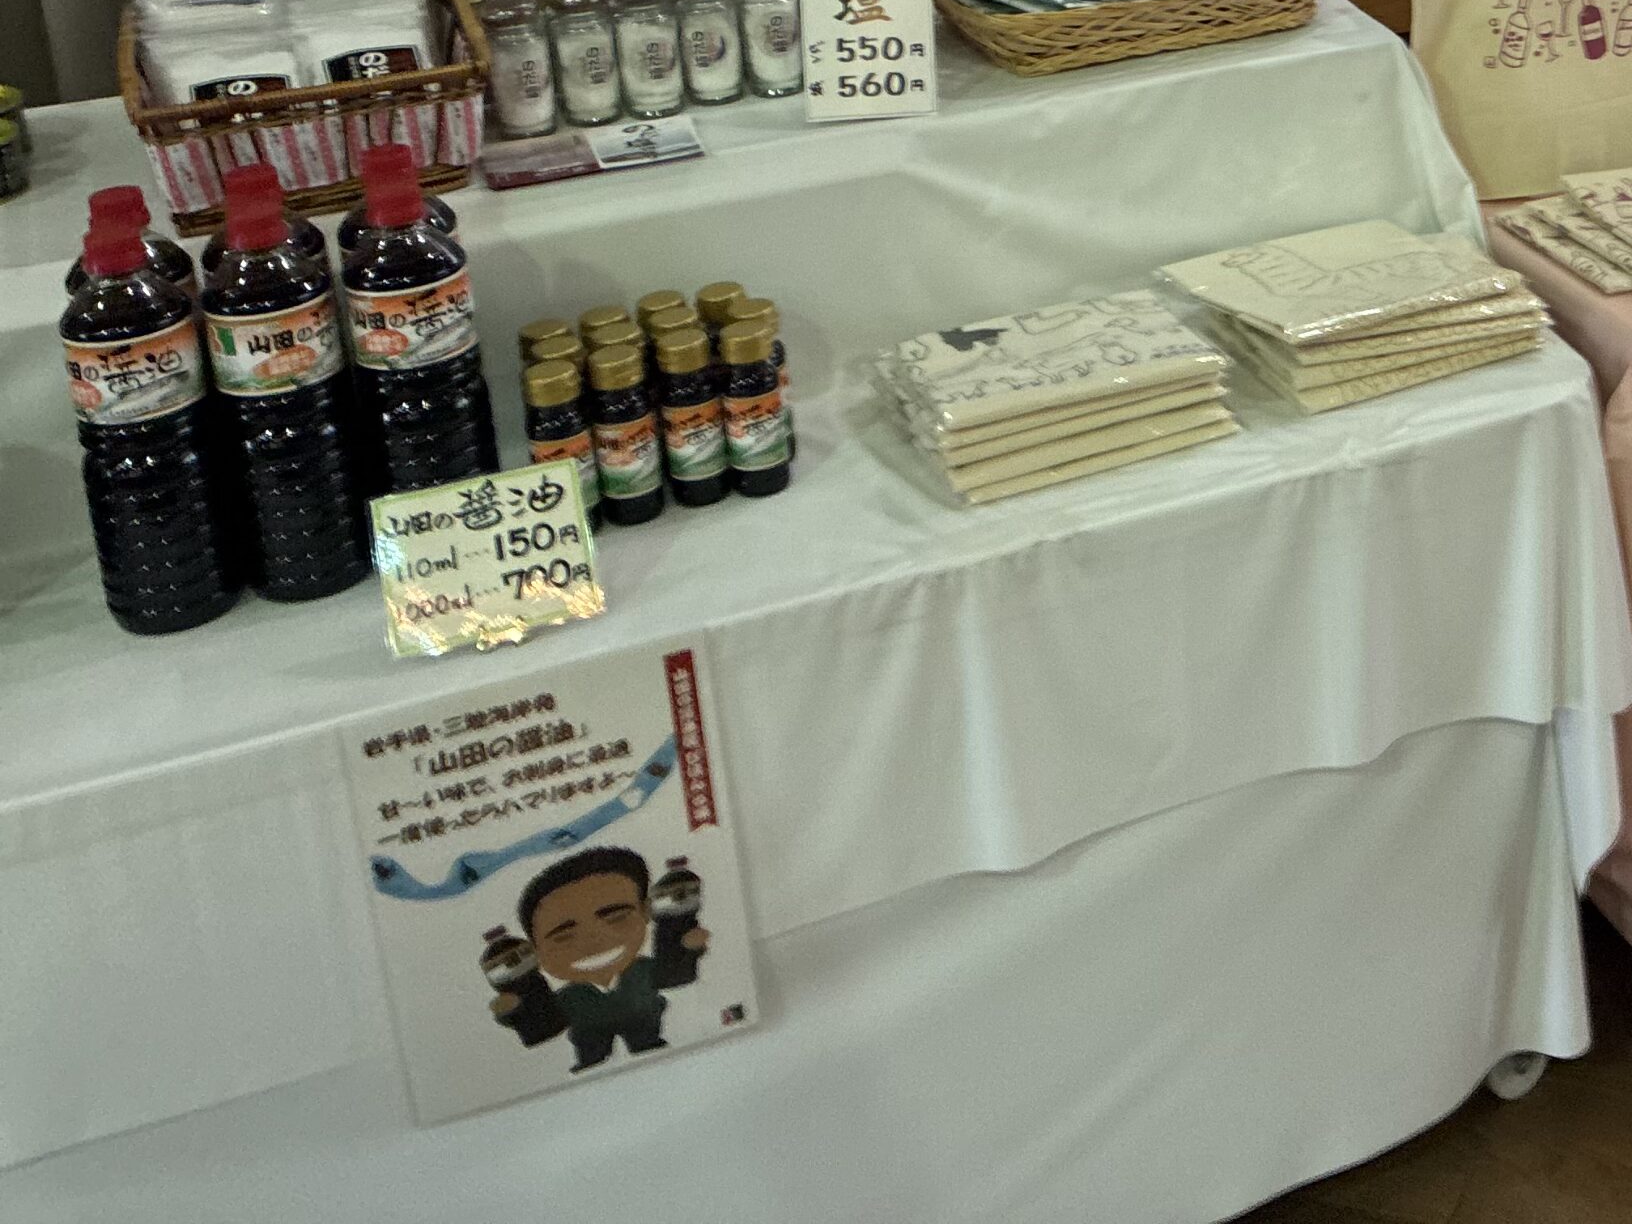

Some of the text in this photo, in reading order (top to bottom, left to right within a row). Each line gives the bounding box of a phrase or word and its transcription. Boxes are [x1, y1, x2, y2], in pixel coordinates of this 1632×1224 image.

[835, 35, 926, 64] 550円
[837, 71, 926, 98] 560円
[387, 474, 564, 538] 山田の醤油
[492, 521, 581, 562] 150円
